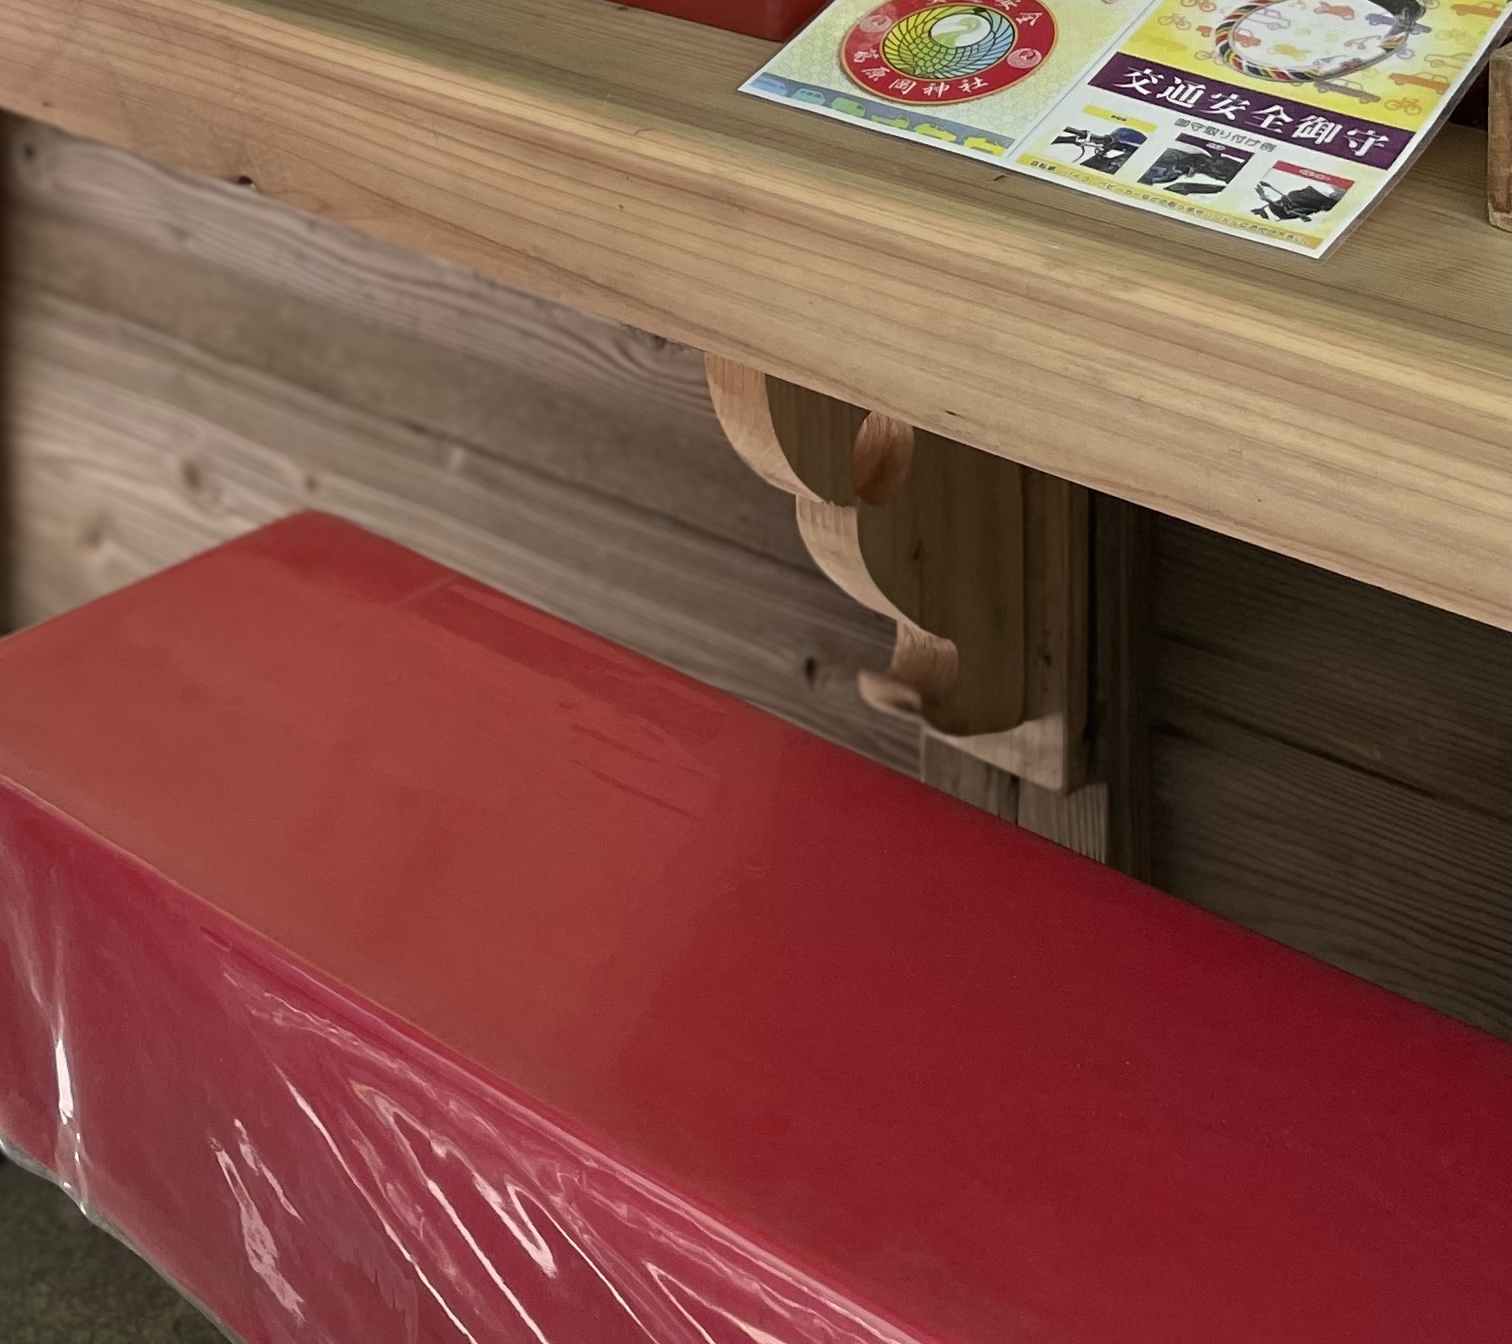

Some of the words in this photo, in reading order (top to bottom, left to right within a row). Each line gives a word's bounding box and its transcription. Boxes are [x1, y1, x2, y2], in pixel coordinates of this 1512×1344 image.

[1115, 67, 1390, 159] 交通安全御守
